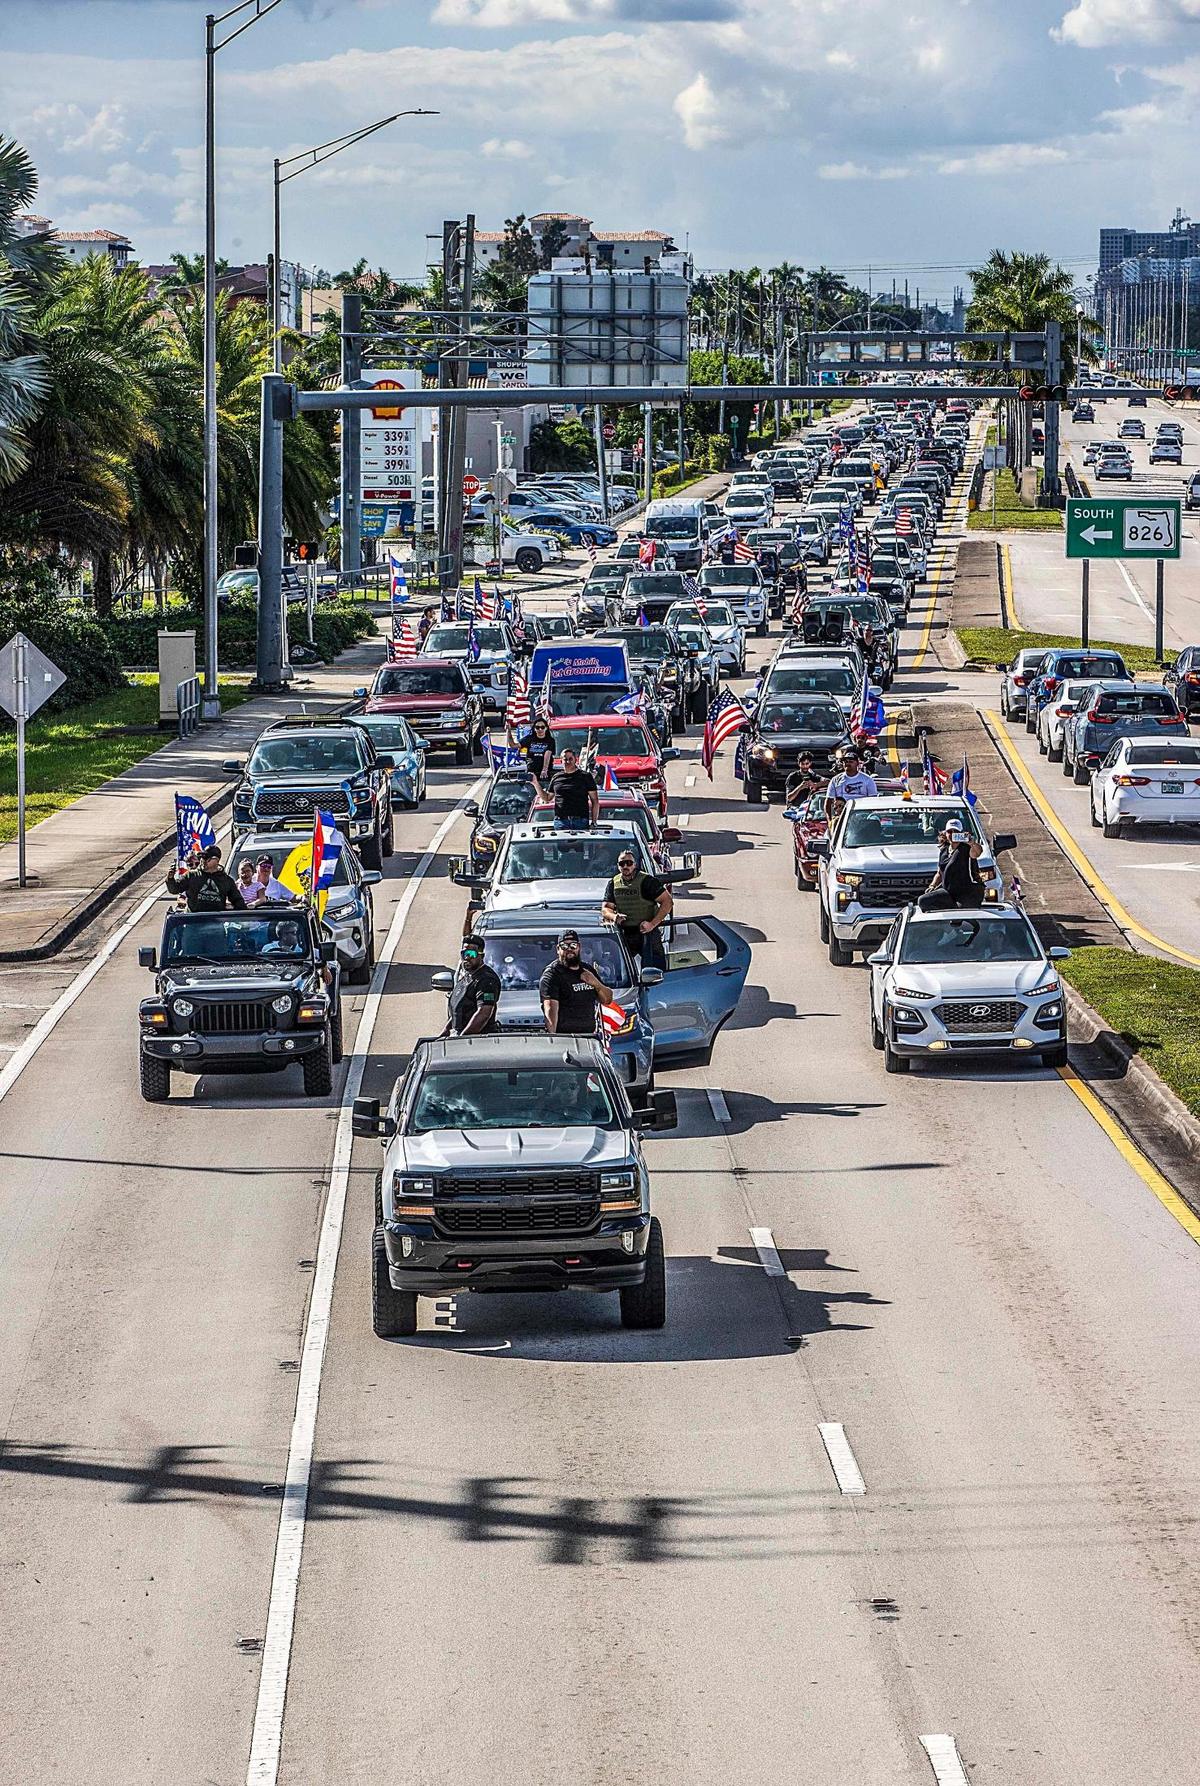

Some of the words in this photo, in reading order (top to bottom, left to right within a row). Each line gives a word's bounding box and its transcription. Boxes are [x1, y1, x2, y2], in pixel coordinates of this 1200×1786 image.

[384, 431, 403, 442] 339
[384, 445, 404, 456] 359
[384, 459, 404, 470] 399
[387, 475, 405, 486] 503
[463, 481, 479, 490] STOP
[363, 508, 384, 516] SHOP
[1074, 508, 1114, 519] SOUTH
[1128, 526, 1164, 541] 826
[563, 665, 612, 677] Grooming
